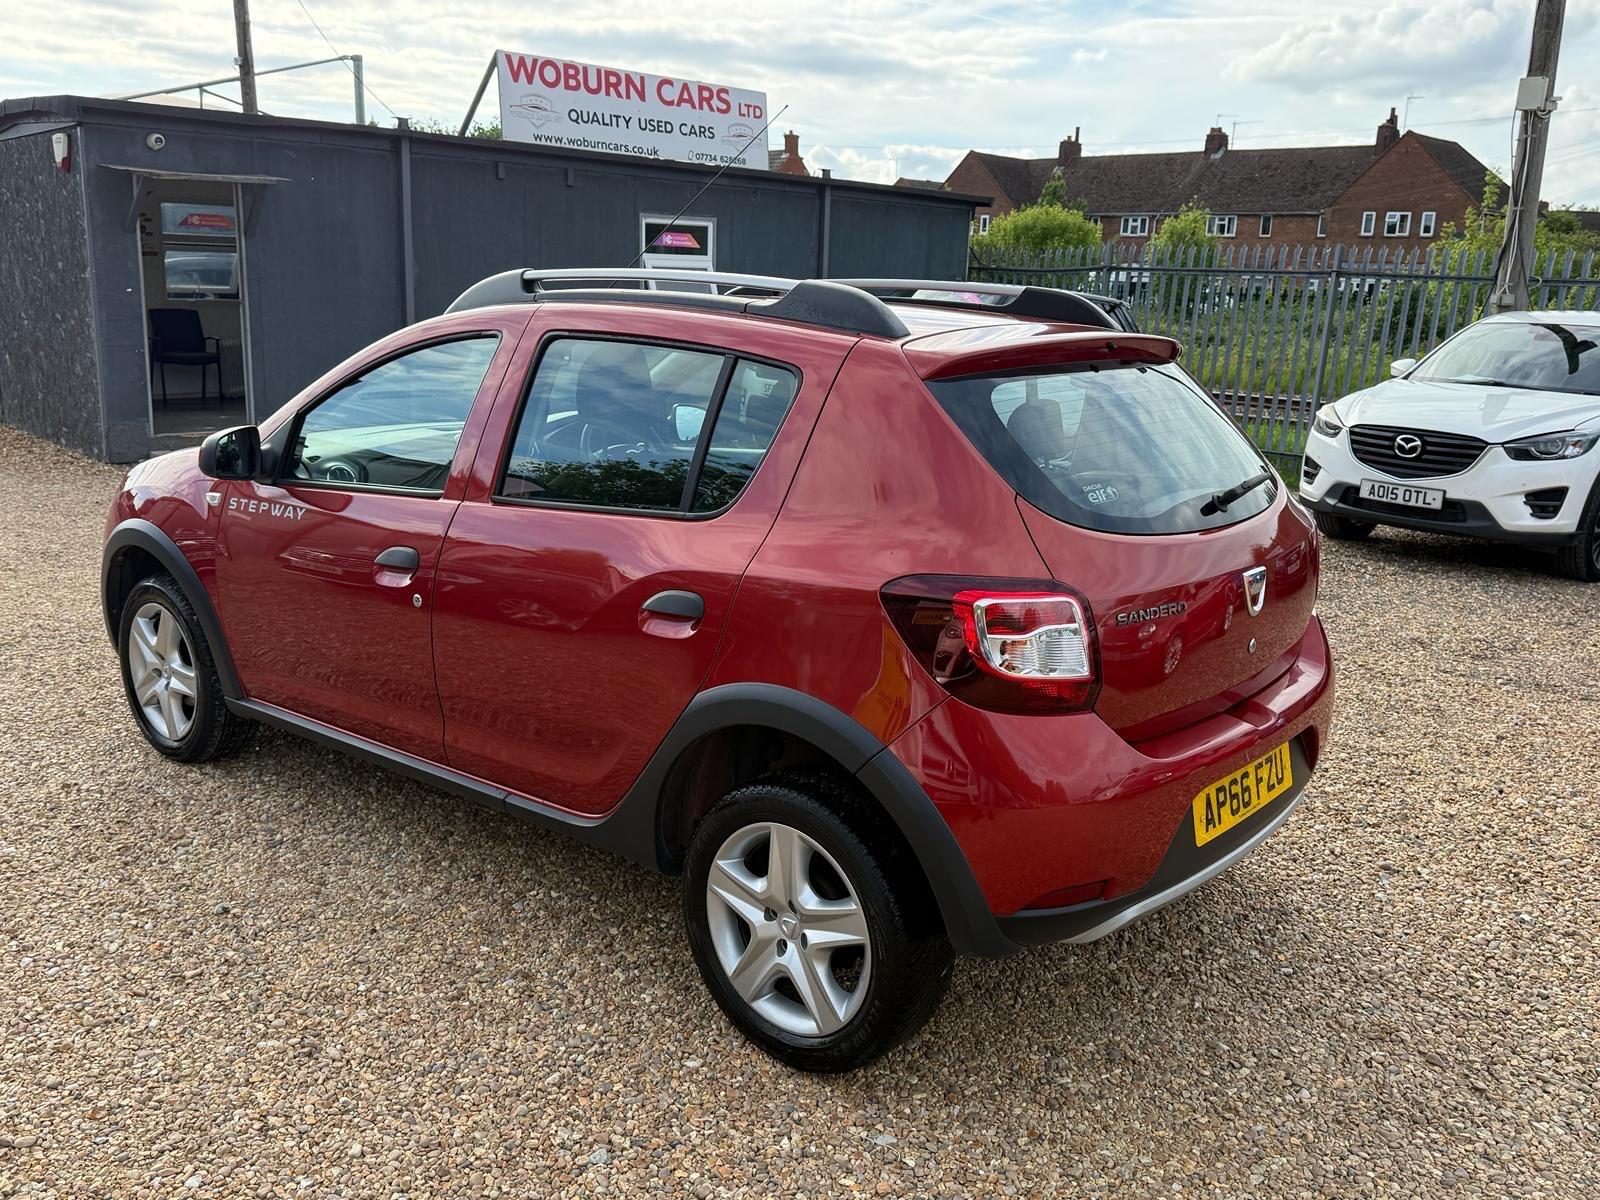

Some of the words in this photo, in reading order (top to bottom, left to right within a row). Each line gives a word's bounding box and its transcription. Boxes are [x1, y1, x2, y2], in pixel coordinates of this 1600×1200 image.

[504, 53, 647, 103] WOBURN
[656, 78, 732, 115] CARS
[738, 102, 764, 120] LTD
[567, 108, 633, 130] QUALITY
[638, 115, 674, 135] USED
[679, 122, 716, 140] CARS
[533, 132, 660, 157] www.woburncars.co.uk
[695, 152, 718, 162] 07734
[1082, 483, 1103, 492] DACIA
[1088, 488, 1107, 503] elf
[1368, 483, 1399, 501] AO15
[1402, 488, 1432, 506] OTL
[228, 497, 306, 520] STEPWAY
[1115, 600, 1188, 627] SANDERO
[1204, 770, 1252, 834] AP66
[1254, 747, 1285, 801] FZU
